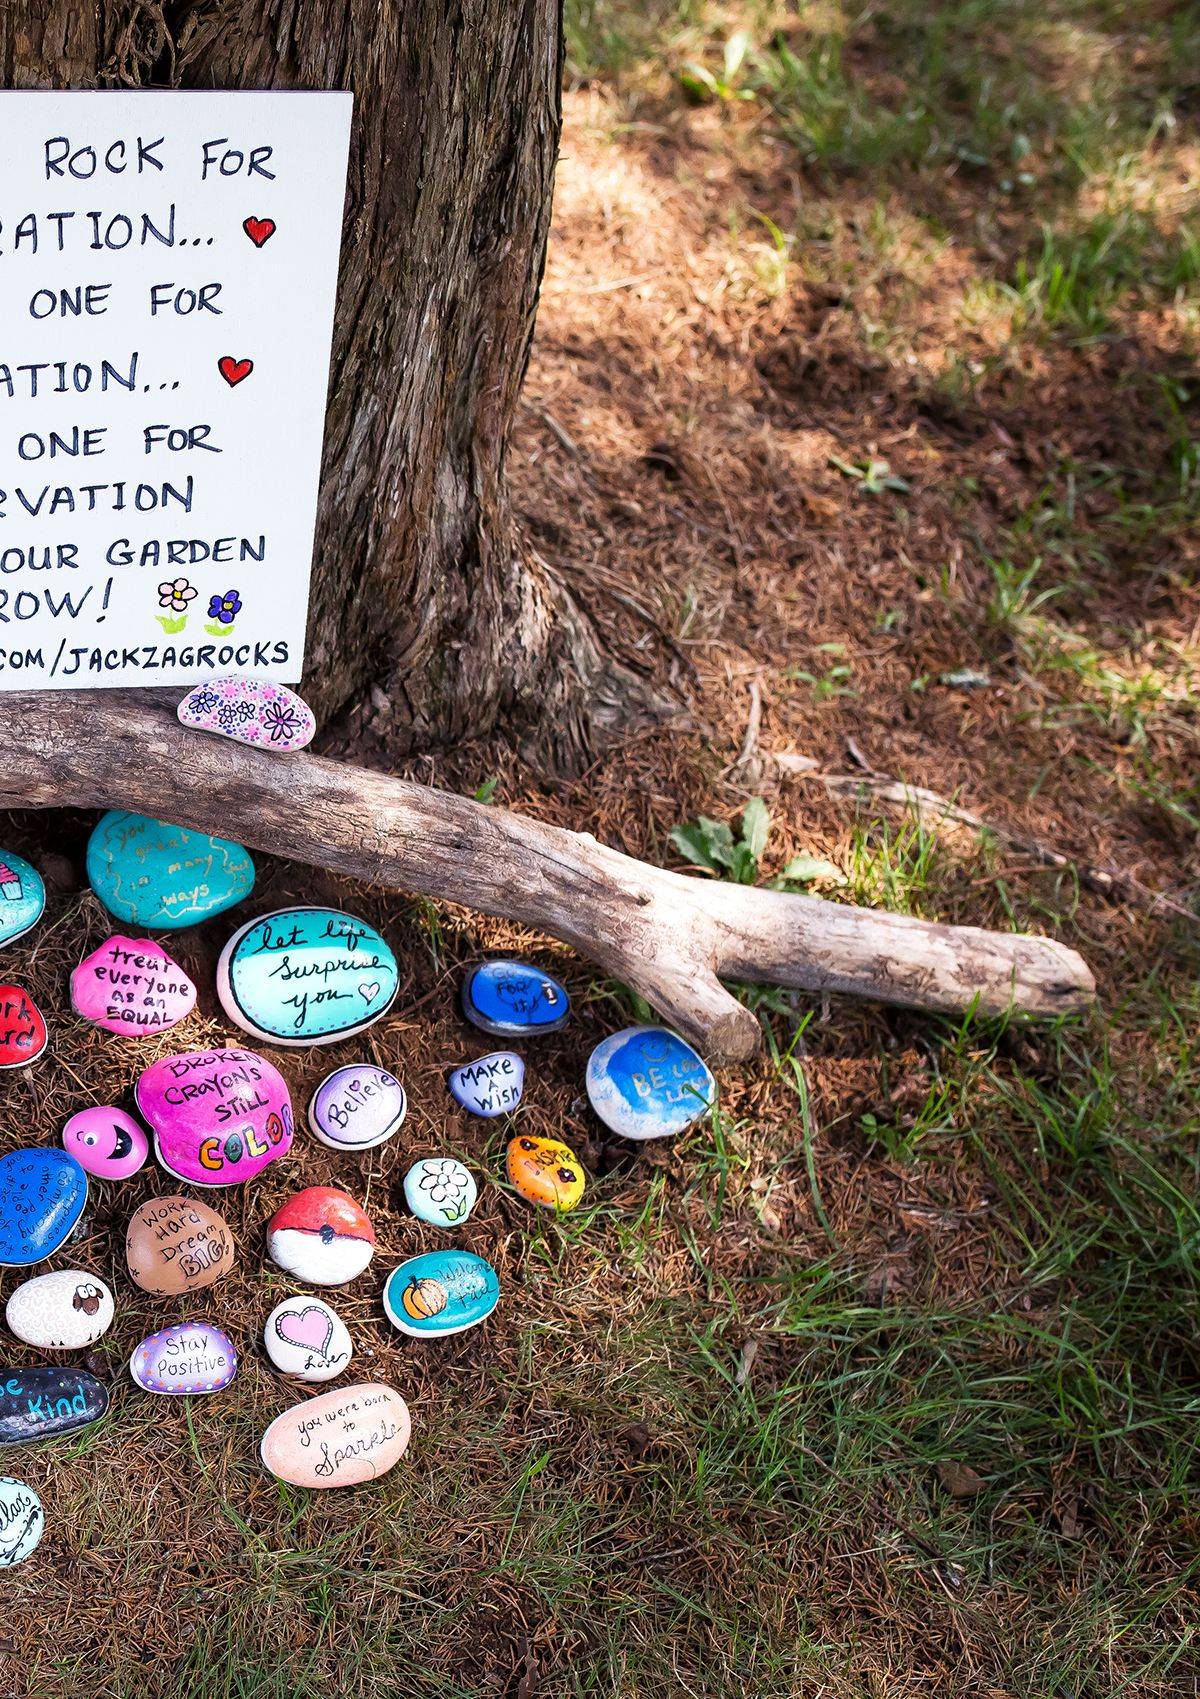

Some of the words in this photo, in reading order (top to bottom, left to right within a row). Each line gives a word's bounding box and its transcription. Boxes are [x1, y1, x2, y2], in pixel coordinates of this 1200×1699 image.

[44, 135, 166, 181] ROCK
[201, 137, 276, 180] FOR
[29, 283, 112, 320] ONE
[150, 282, 224, 318] FOR
[18, 425, 108, 462] ONE
[145, 424, 223, 455] FOR
[0, 543, 79, 574] OUR
[105, 535, 267, 568] GARDEN
[252, 926, 308, 955] let
[319, 919, 378, 952] life
[109, 946, 173, 973] treat
[269, 956, 393, 983] Surprie
[106, 1006, 174, 1026] EQUAL
[282, 989, 353, 1028] you
[328, 1074, 396, 1129] Believe
[199, 1103, 293, 1170] COLOR
[161, 1224, 216, 1263] Dream
[166, 1334, 209, 1356] Stay
[157, 1354, 226, 1378] Positive
[27, 1384, 87, 1422] Kind
[298, 1418, 322, 1447] you
[325, 1403, 359, 1422] were
[343, 1421, 355, 1432] to
